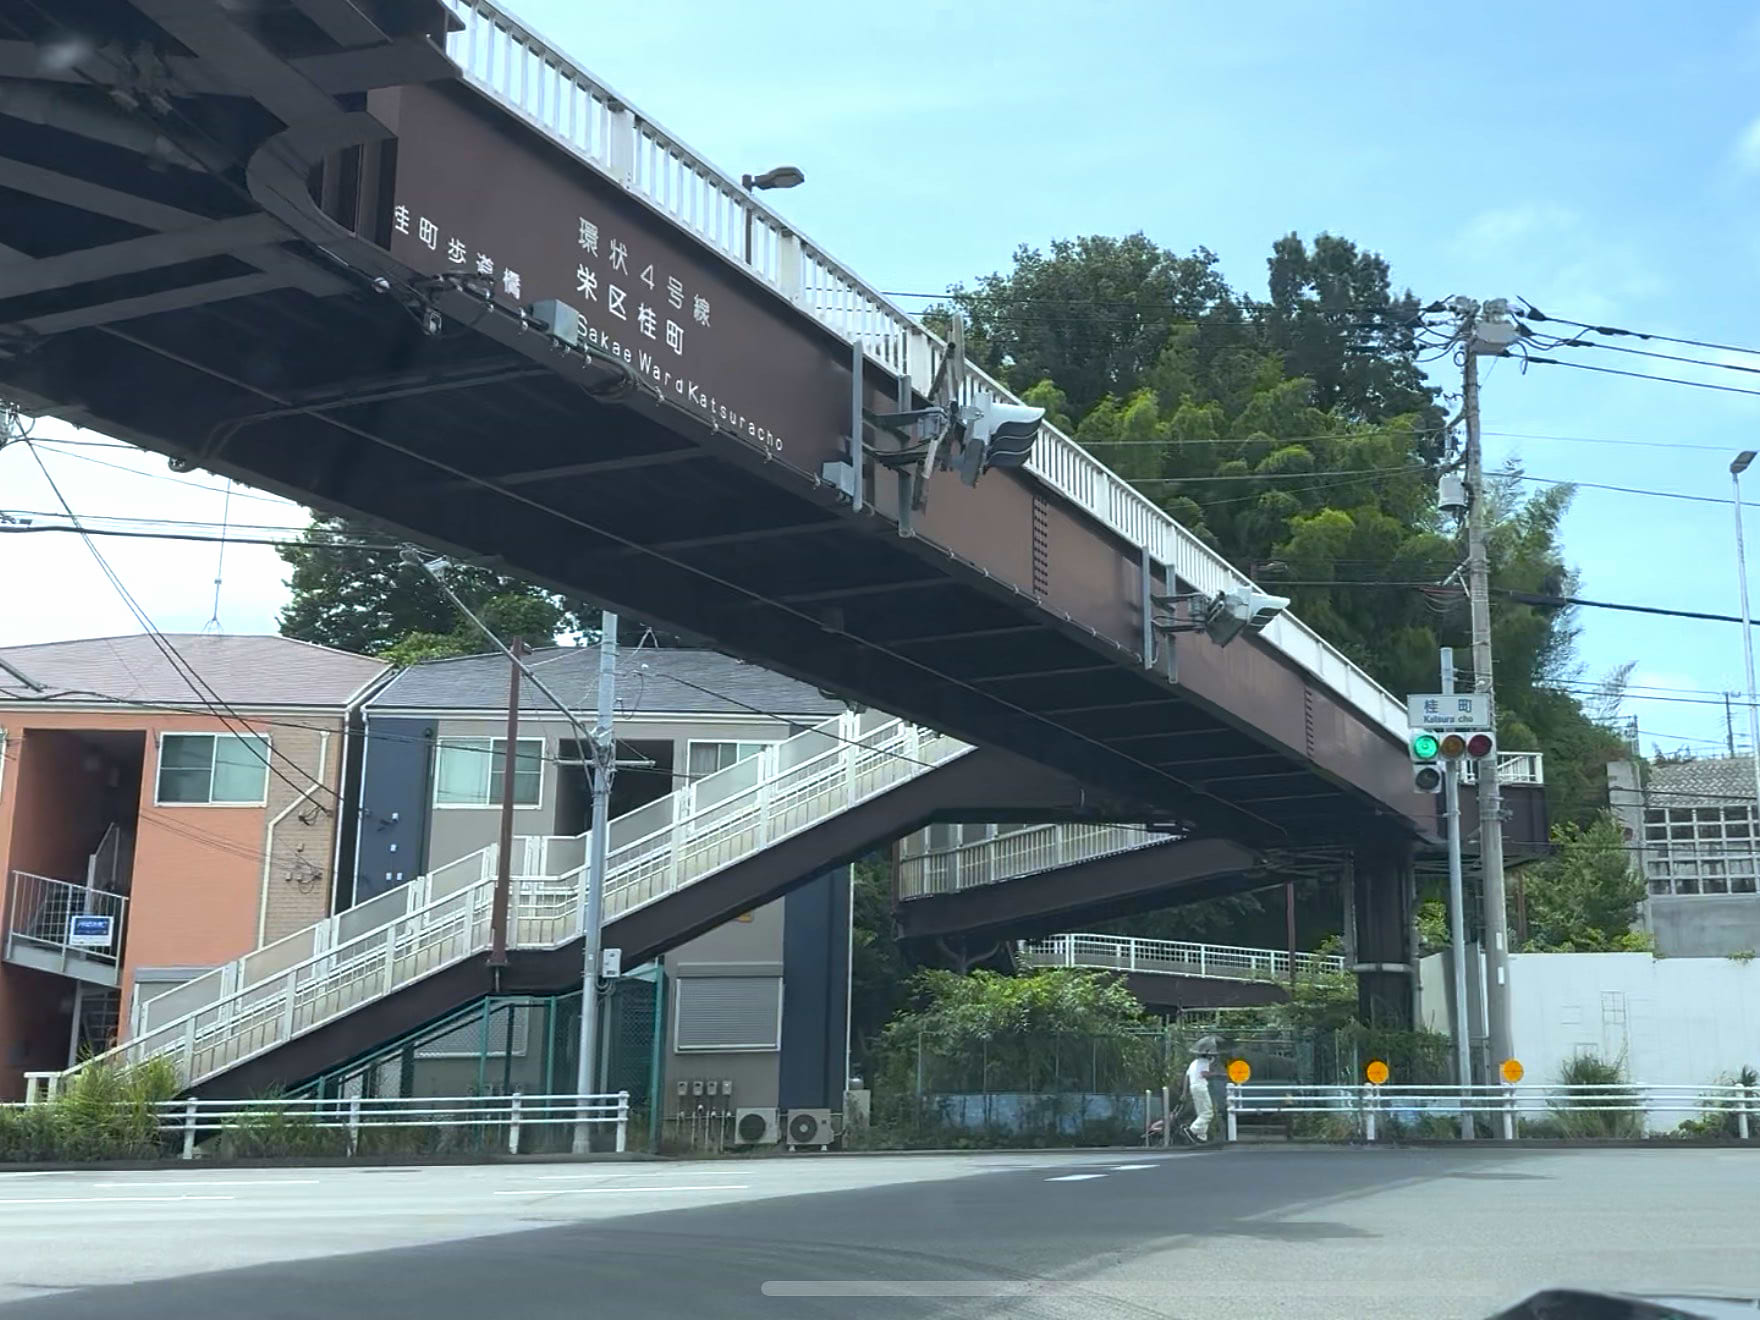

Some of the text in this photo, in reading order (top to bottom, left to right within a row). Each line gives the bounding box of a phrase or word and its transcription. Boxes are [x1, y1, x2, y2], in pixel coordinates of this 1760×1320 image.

[576, 264, 684, 355] 栄区桂町
[577, 217, 711, 327] 環状4号線
[577, 314, 784, 451] Sakae Ward Katsuracho
[1424, 698, 1472, 714] 桂町
